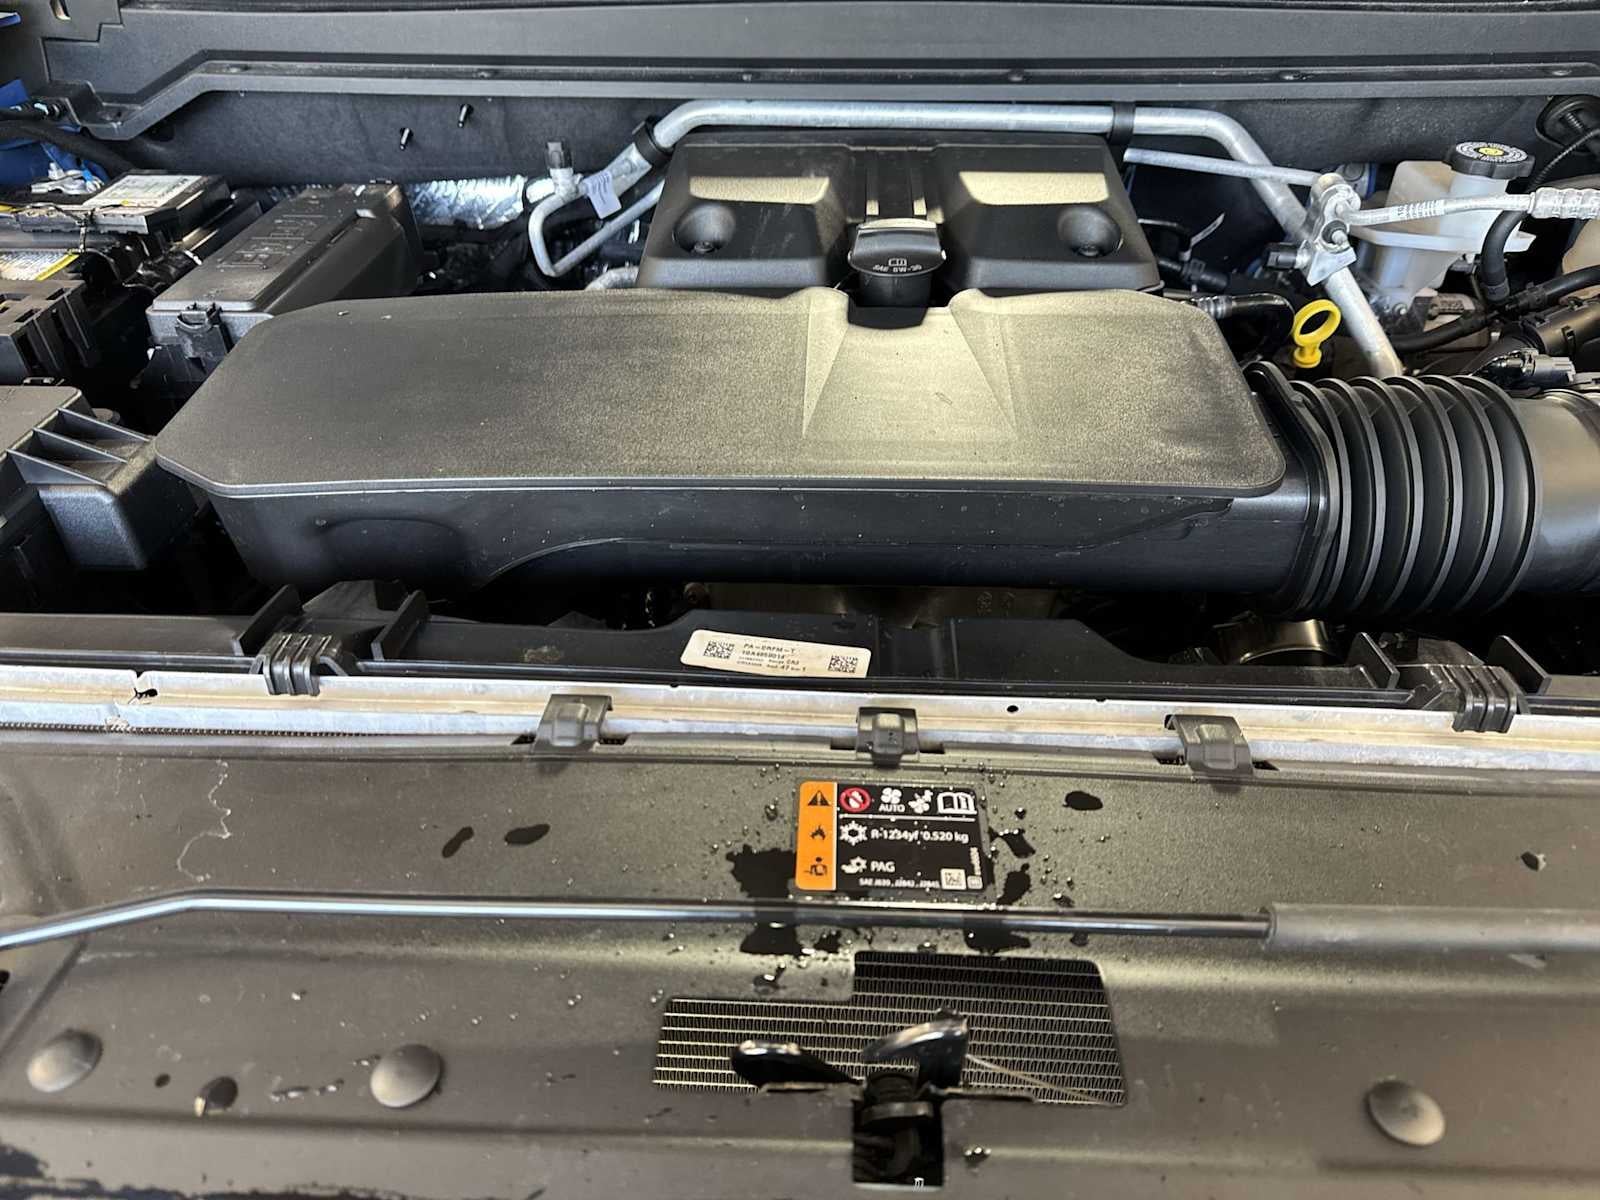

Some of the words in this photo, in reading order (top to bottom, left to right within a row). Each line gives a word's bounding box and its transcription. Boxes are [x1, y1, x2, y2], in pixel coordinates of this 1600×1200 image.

[878, 803, 906, 813] AUTO
[870, 828, 919, 842] R-1234yf
[922, 831, 953, 841] 0.520
[954, 831, 969, 844] kg
[870, 861, 896, 873] PAG
